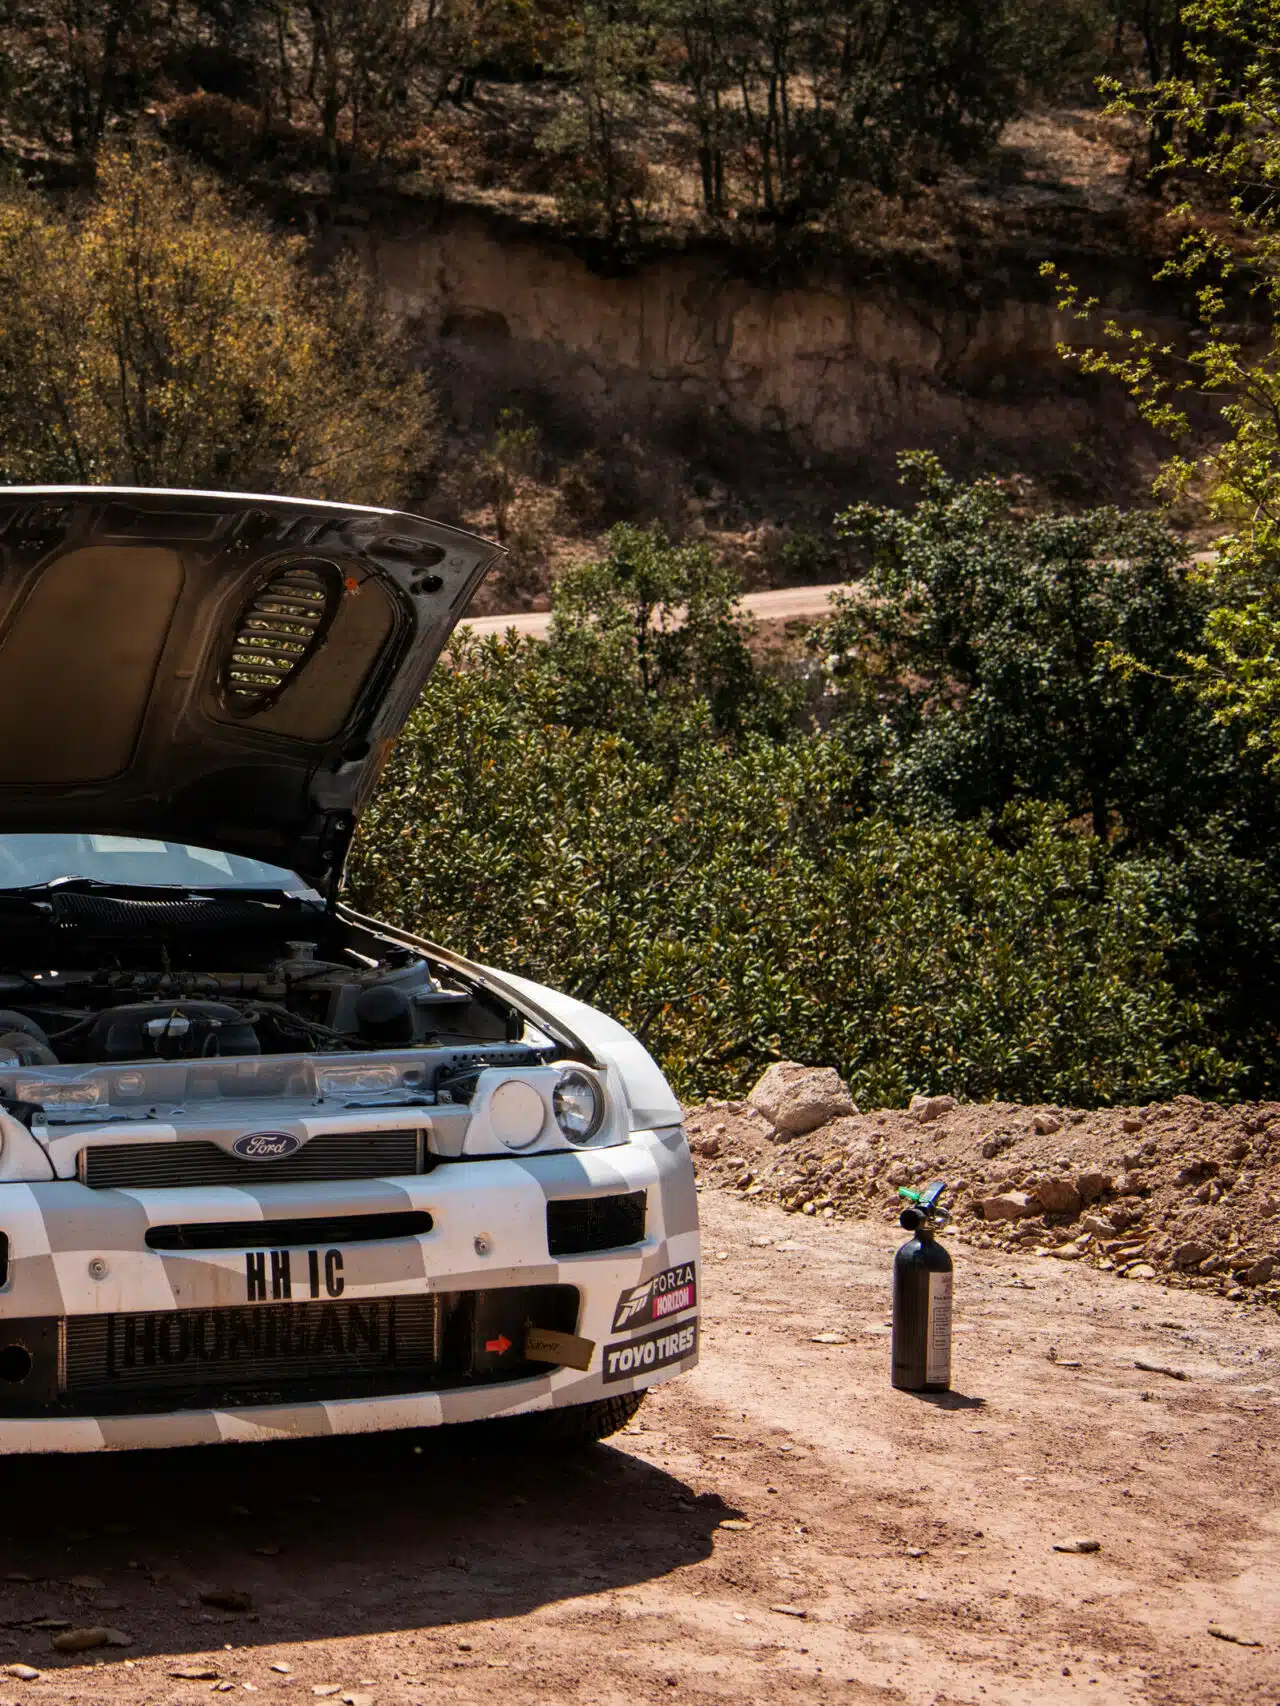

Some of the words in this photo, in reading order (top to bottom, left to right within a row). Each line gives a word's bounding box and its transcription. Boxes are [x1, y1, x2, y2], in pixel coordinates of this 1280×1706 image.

[246, 1135, 287, 1155] Ford
[653, 1266, 694, 1296] FORZA
[657, 1287, 690, 1316] HORIZON
[608, 1342, 656, 1374] TOYO
[657, 1326, 695, 1360] TIRES
